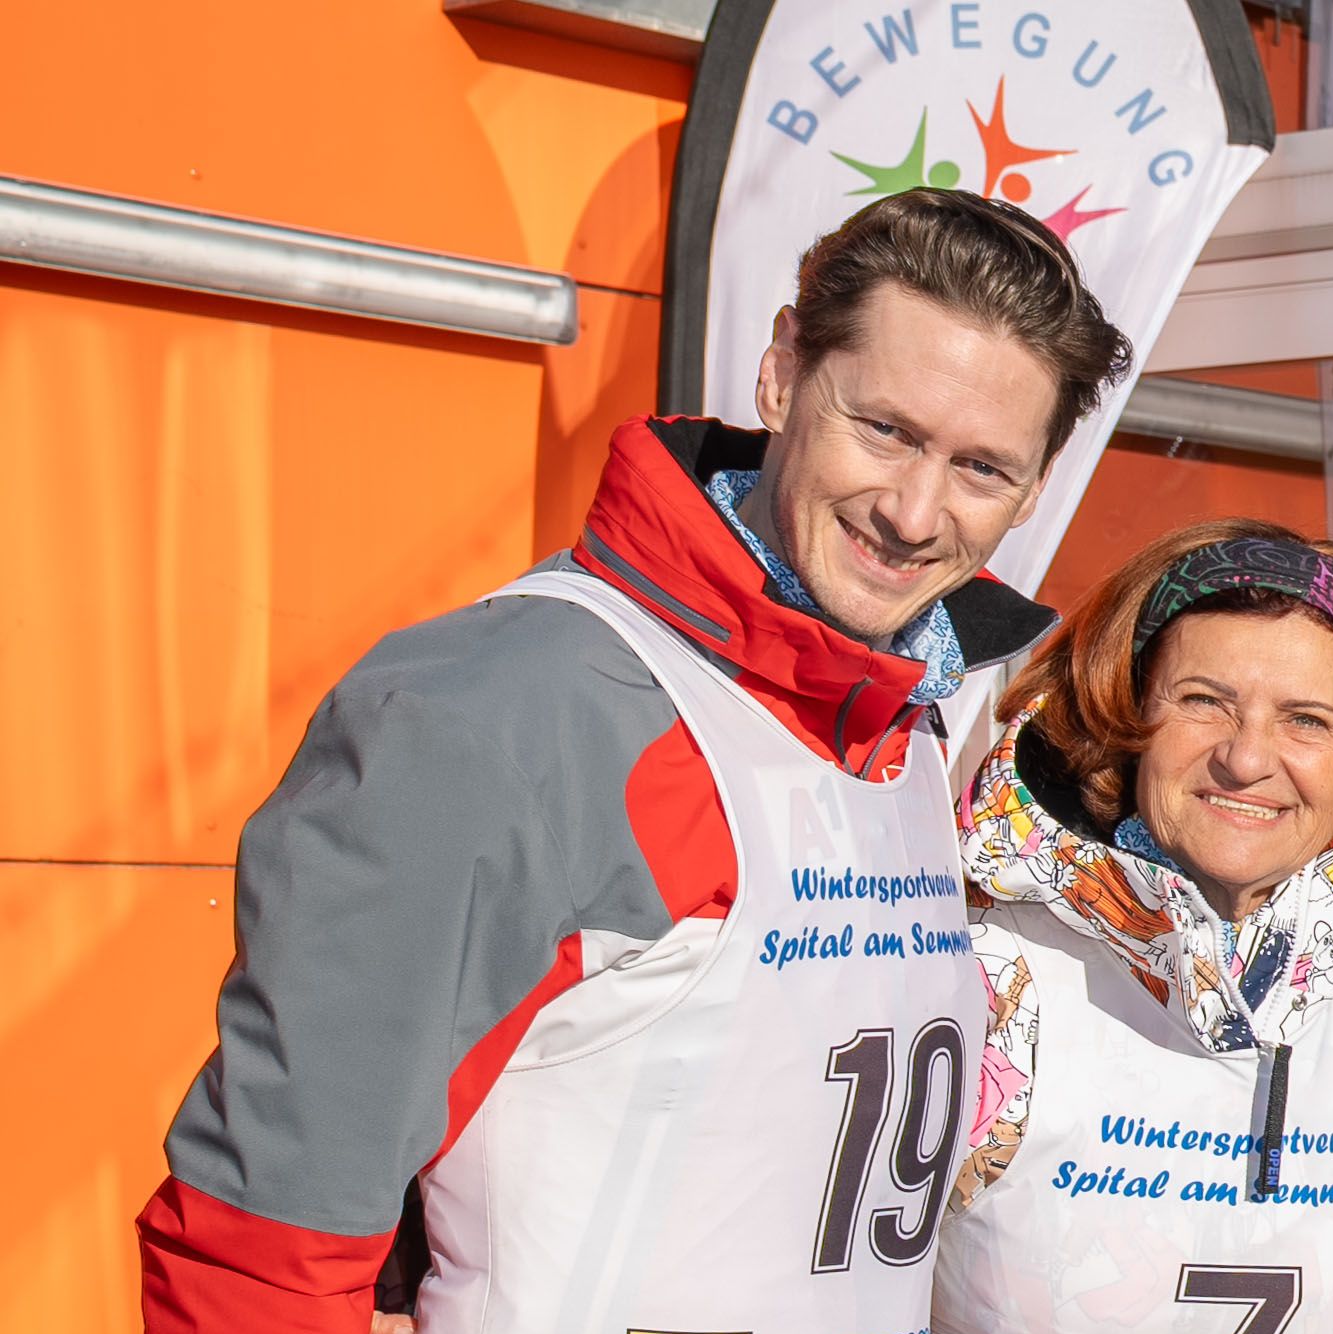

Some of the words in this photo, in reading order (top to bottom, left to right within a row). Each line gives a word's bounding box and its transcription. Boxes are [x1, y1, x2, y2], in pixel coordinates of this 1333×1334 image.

[767, 2, 1194, 189] BEWEGUNG
[792, 866, 960, 907] Wintersportverein
[759, 923, 853, 971] Spital
[864, 932, 906, 959] am
[811, 1017, 963, 1275] 19
[1266, 1148, 1280, 1187] OPEN
[1052, 1160, 1170, 1199] Spital
[1179, 1180, 1239, 1206] am
